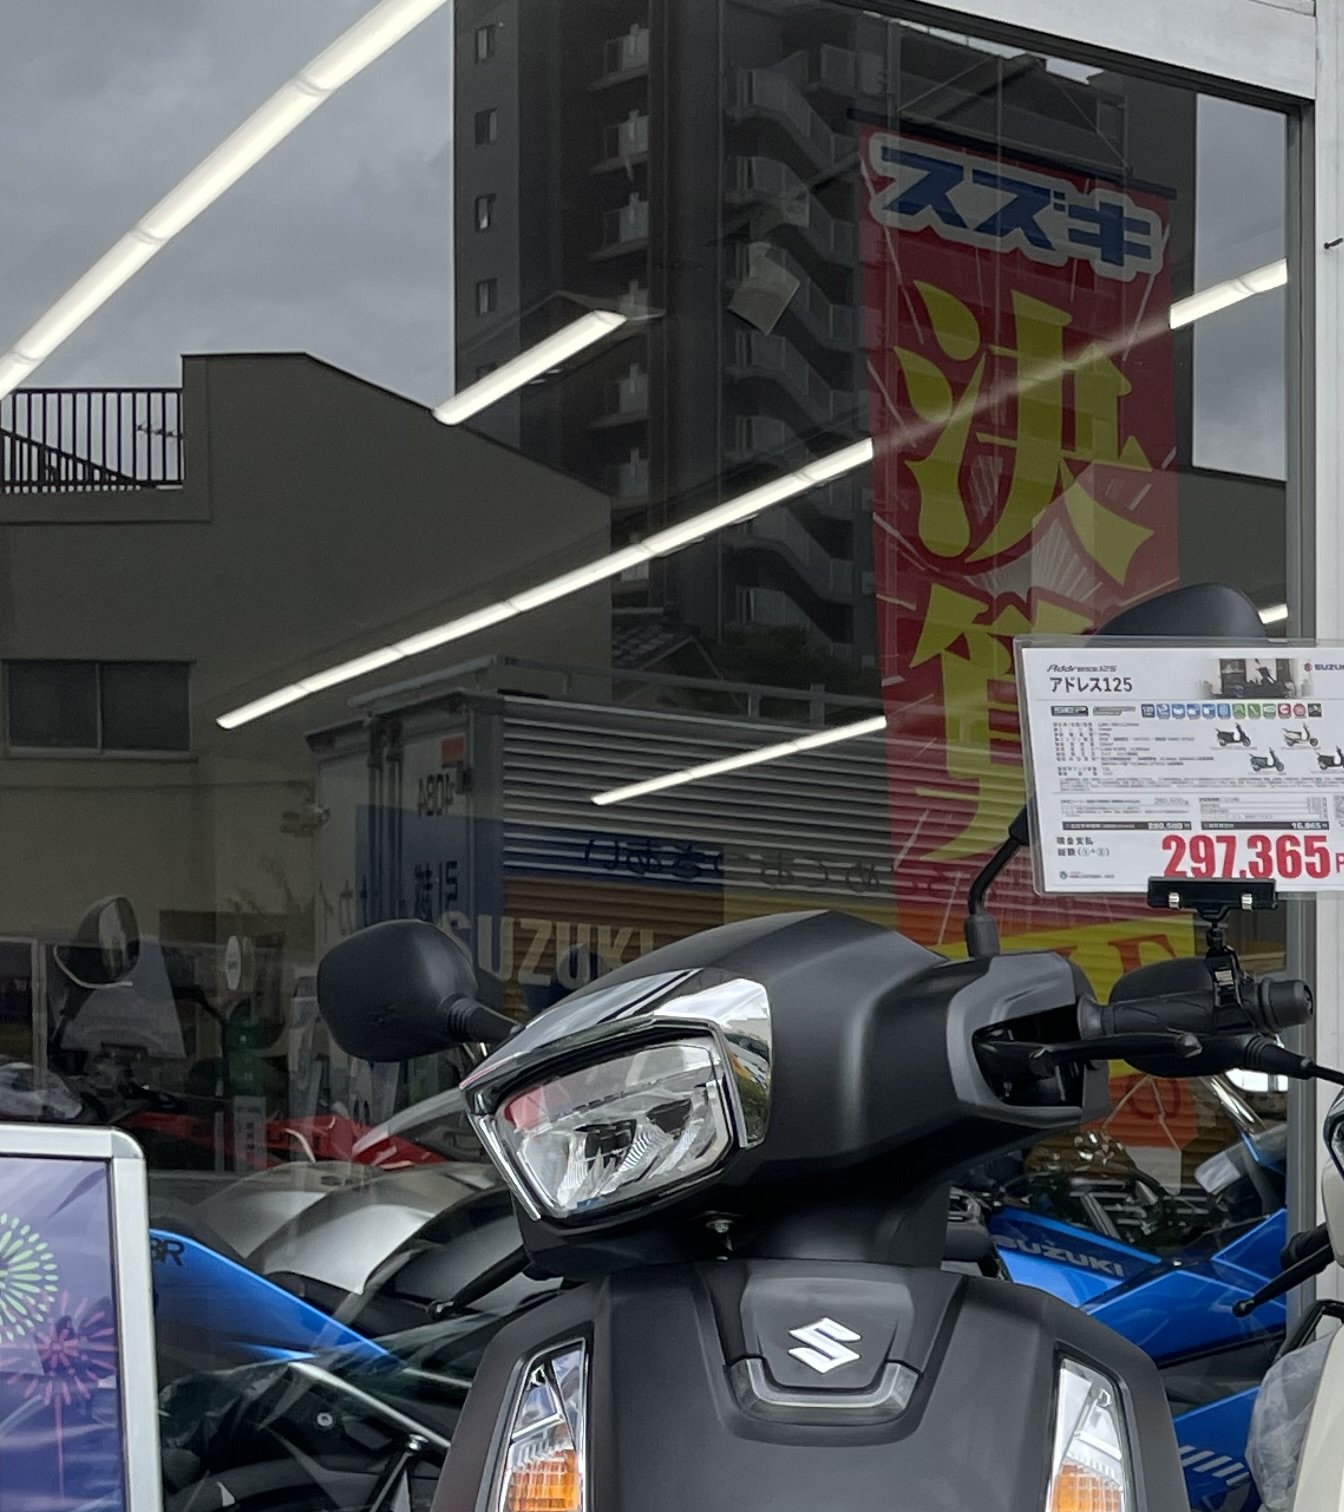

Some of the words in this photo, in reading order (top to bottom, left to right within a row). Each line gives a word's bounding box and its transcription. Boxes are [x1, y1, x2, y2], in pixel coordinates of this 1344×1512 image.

[876, 142, 1156, 270] スズキ
[1049, 676, 1133, 694] アドレス125
[990, 1233, 1126, 1278] SUZUKI
